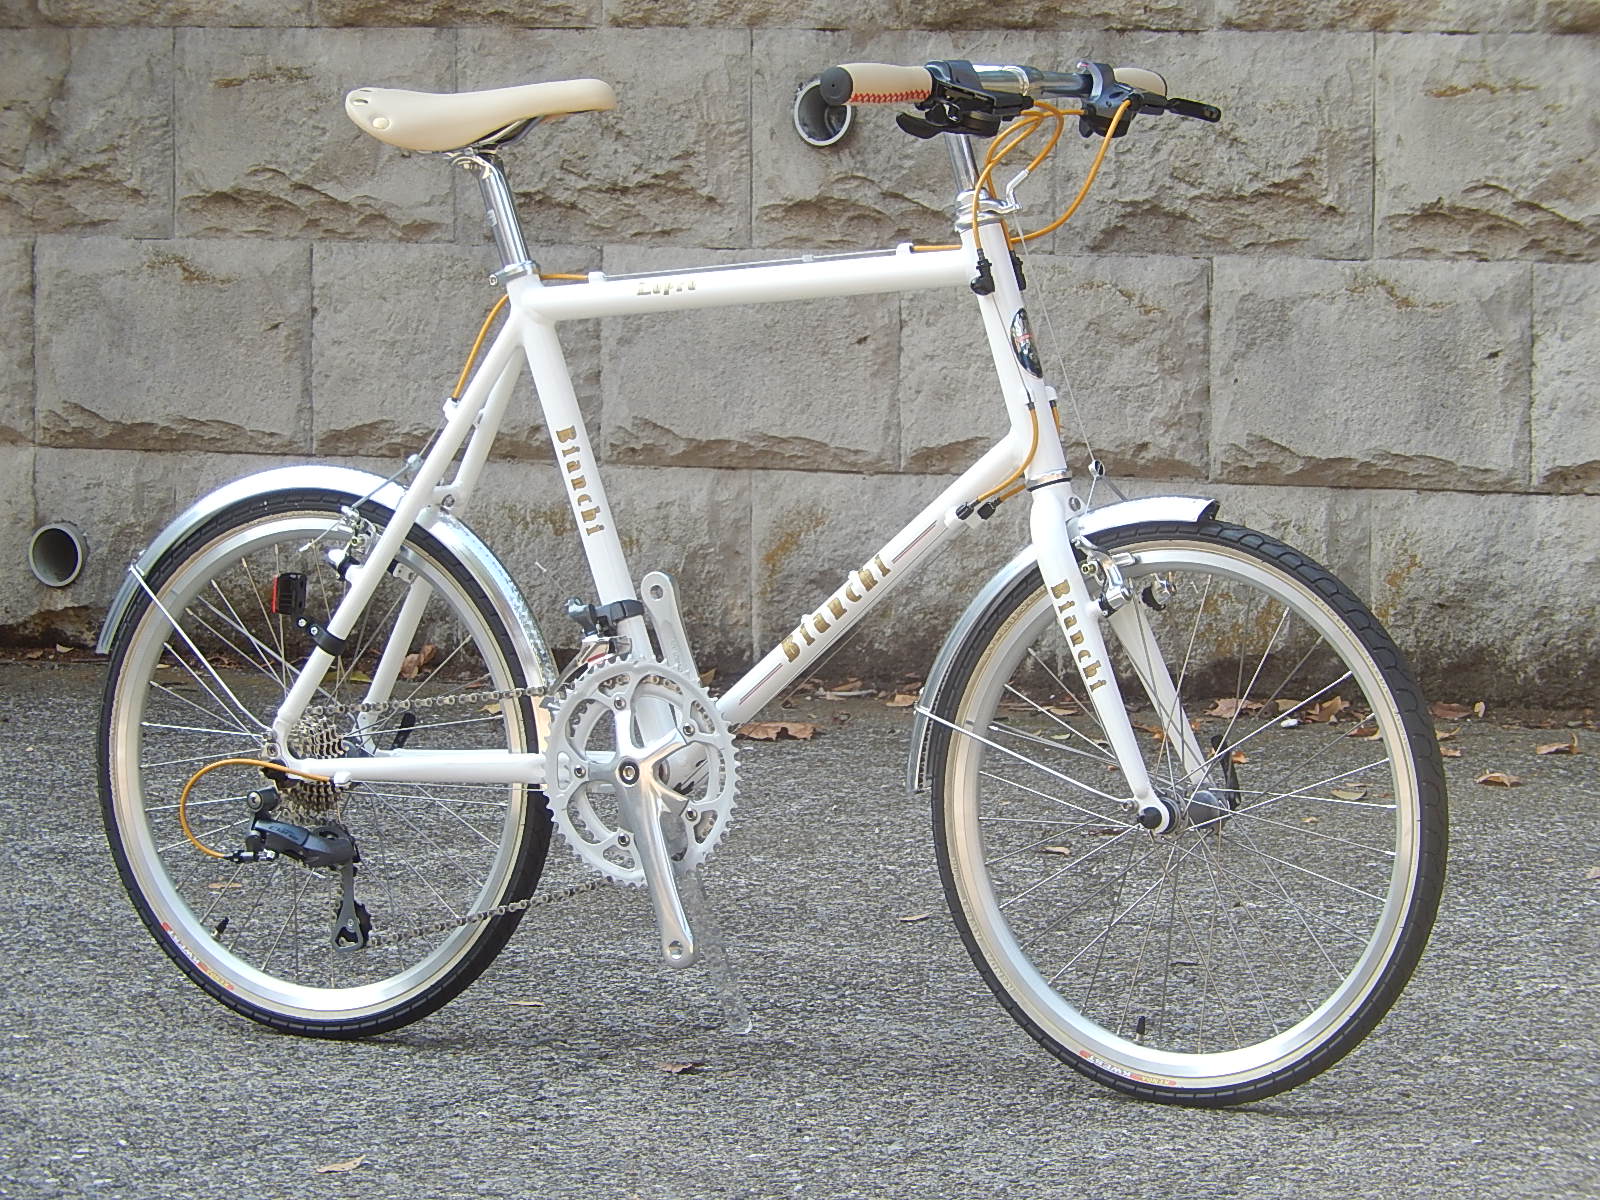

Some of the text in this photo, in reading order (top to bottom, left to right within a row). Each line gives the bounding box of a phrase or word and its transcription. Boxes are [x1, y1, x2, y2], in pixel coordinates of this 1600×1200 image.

[555, 425, 605, 537] Bianchi
[782, 554, 891, 663] Bianchi
[1050, 578, 1107, 692] Bianchi
